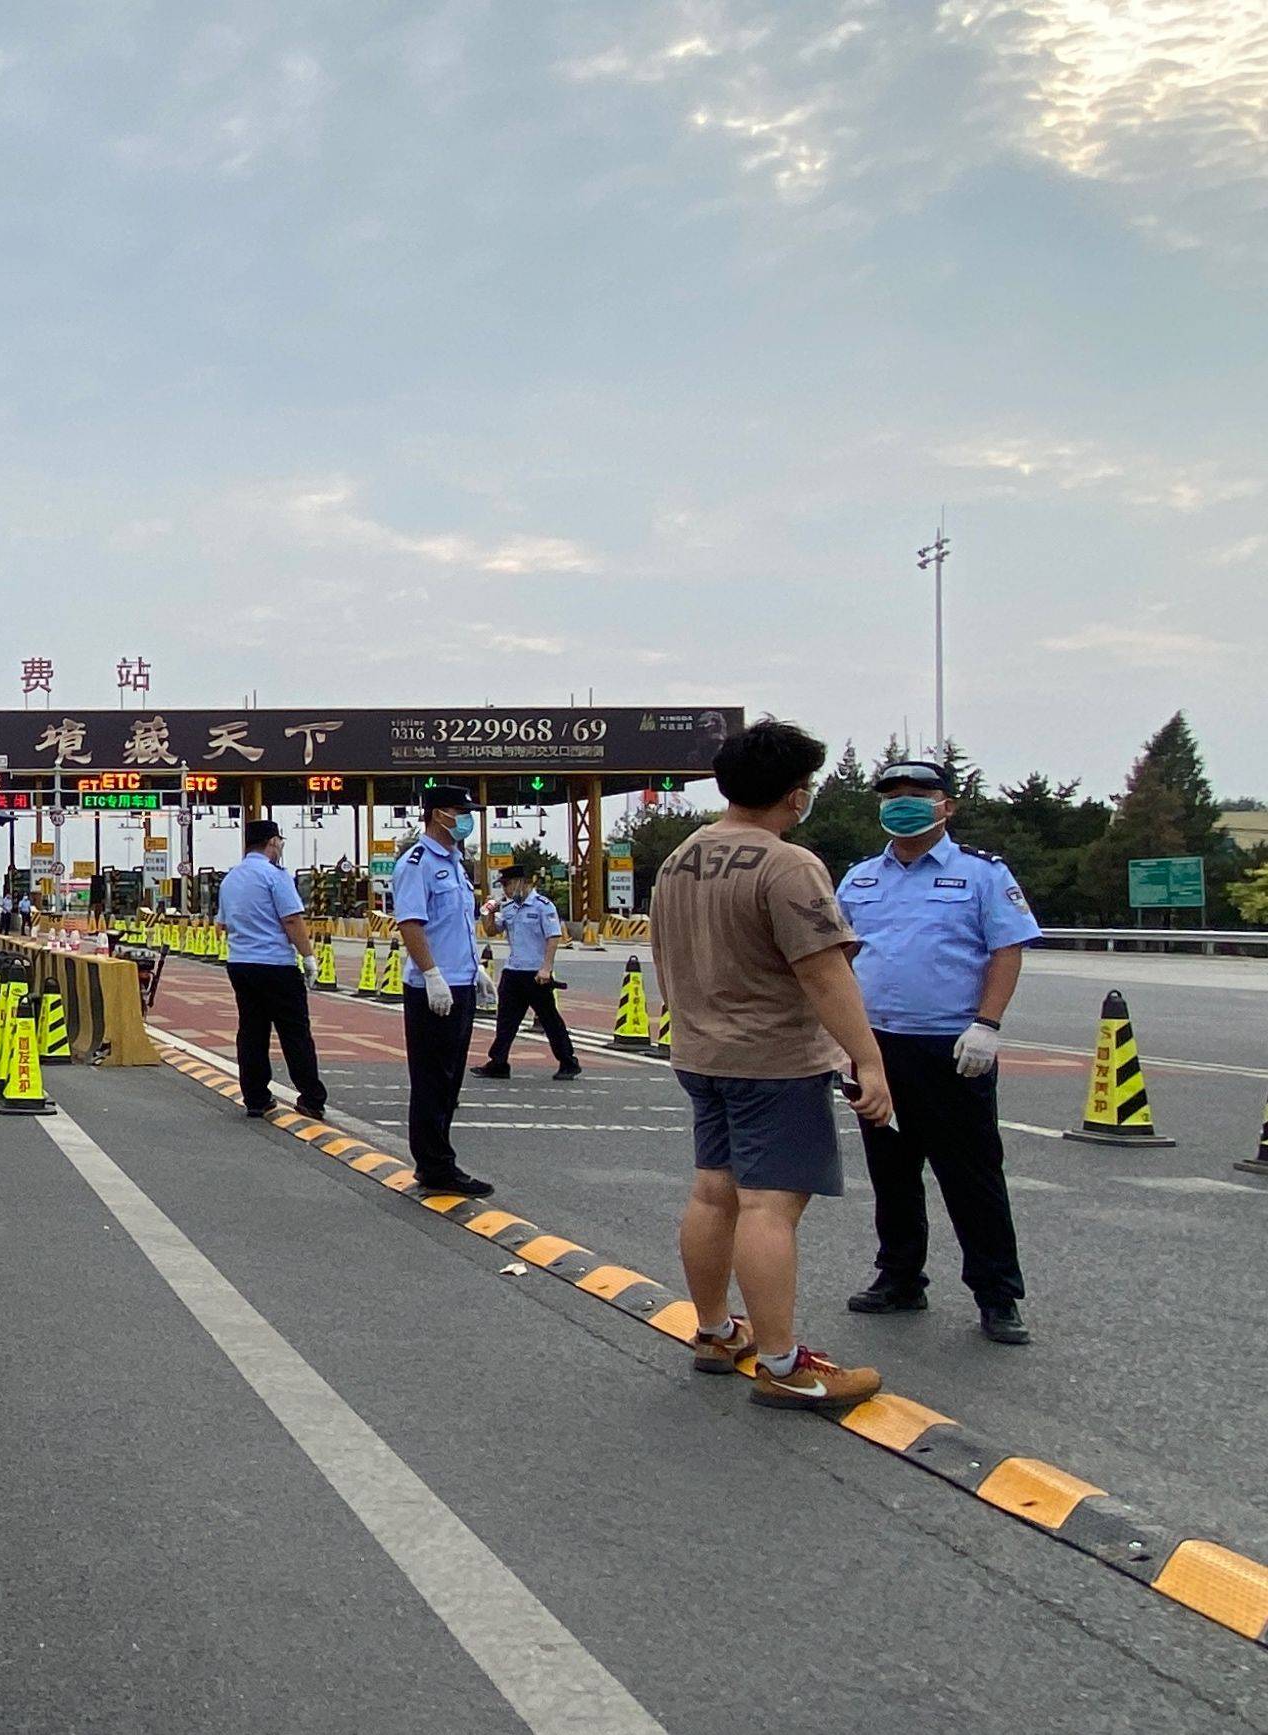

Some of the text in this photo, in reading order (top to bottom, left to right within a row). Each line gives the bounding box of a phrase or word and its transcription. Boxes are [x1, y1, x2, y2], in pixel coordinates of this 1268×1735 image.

[391, 727, 425, 740] 0316
[432, 718, 553, 742] 3229968
[35, 715, 344, 765] 境藏天下
[102, 772, 141, 789] ETC
[185, 777, 218, 791] ETC
[309, 776, 344, 791] ETC
